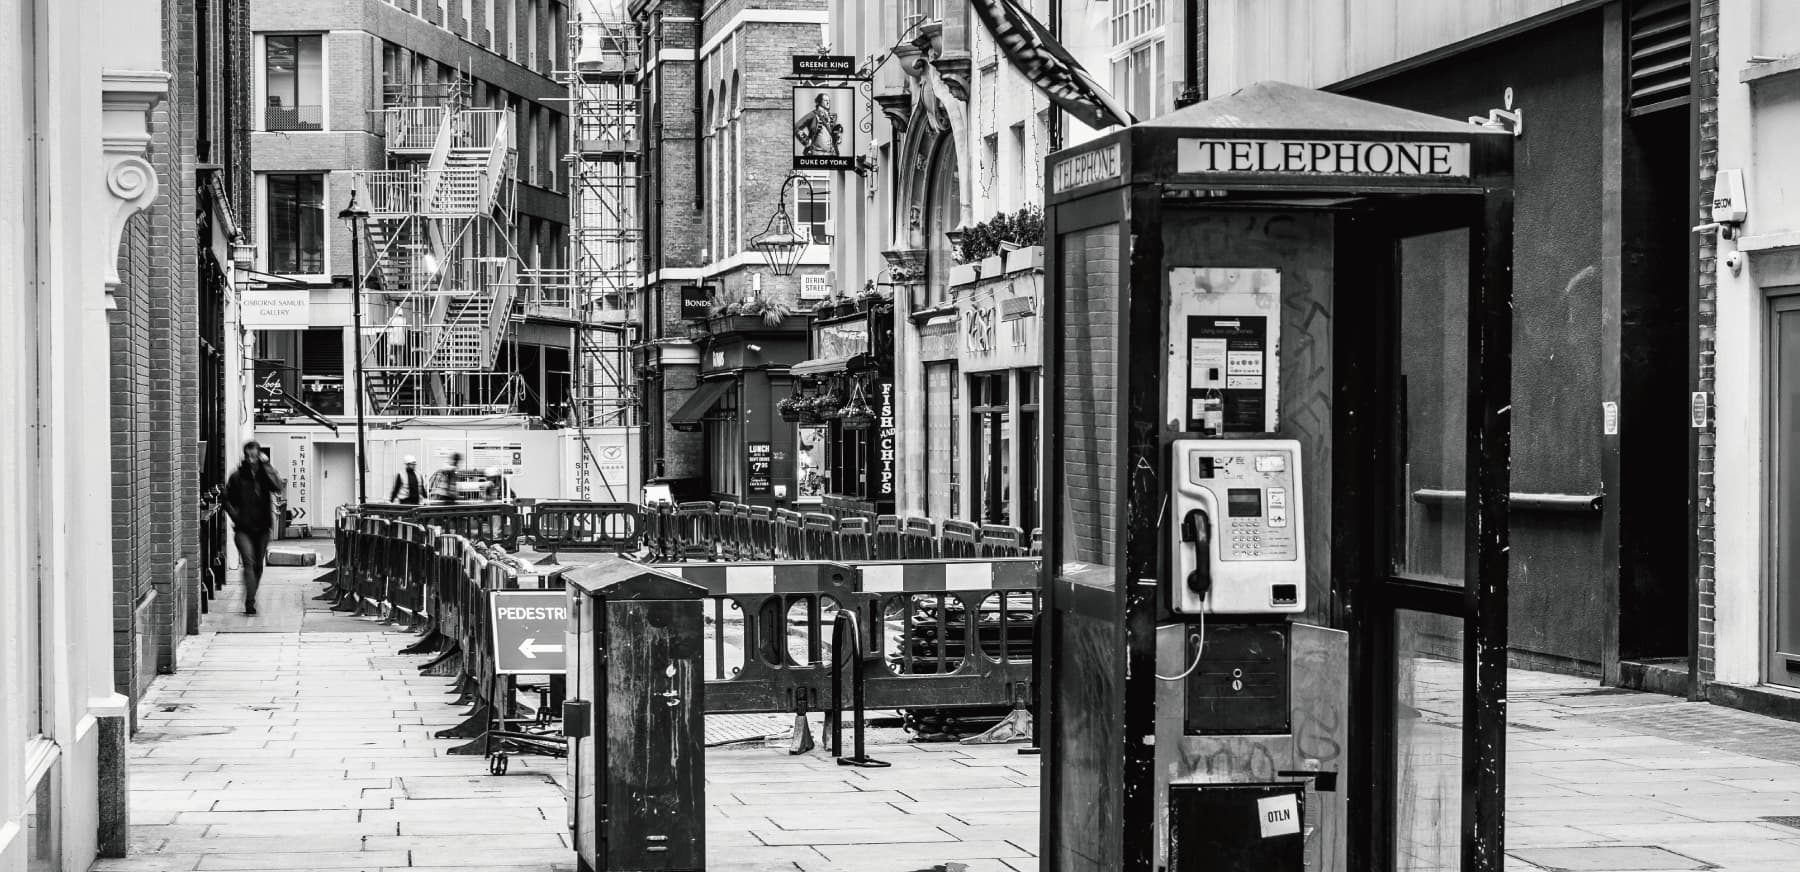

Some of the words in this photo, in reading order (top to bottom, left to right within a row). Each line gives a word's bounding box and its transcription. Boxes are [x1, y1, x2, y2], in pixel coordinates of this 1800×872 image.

[799, 61, 829, 69] GREENE
[830, 61, 849, 69] KING
[1199, 141, 1453, 175] TELEPHONE
[1056, 146, 1116, 190] TELEPHONE
[1714, 197, 1731, 209] SECOM
[685, 299, 712, 307] BONDS
[880, 383, 894, 428] FISH
[880, 428, 895, 439] AND
[749, 444, 770, 453] LUNCH
[583, 446, 591, 500] ENTRANC
[880, 438, 894, 494] CHIPS
[497, 607, 567, 620] PEDESTRI
[1267, 808, 1291, 823] OTLN
